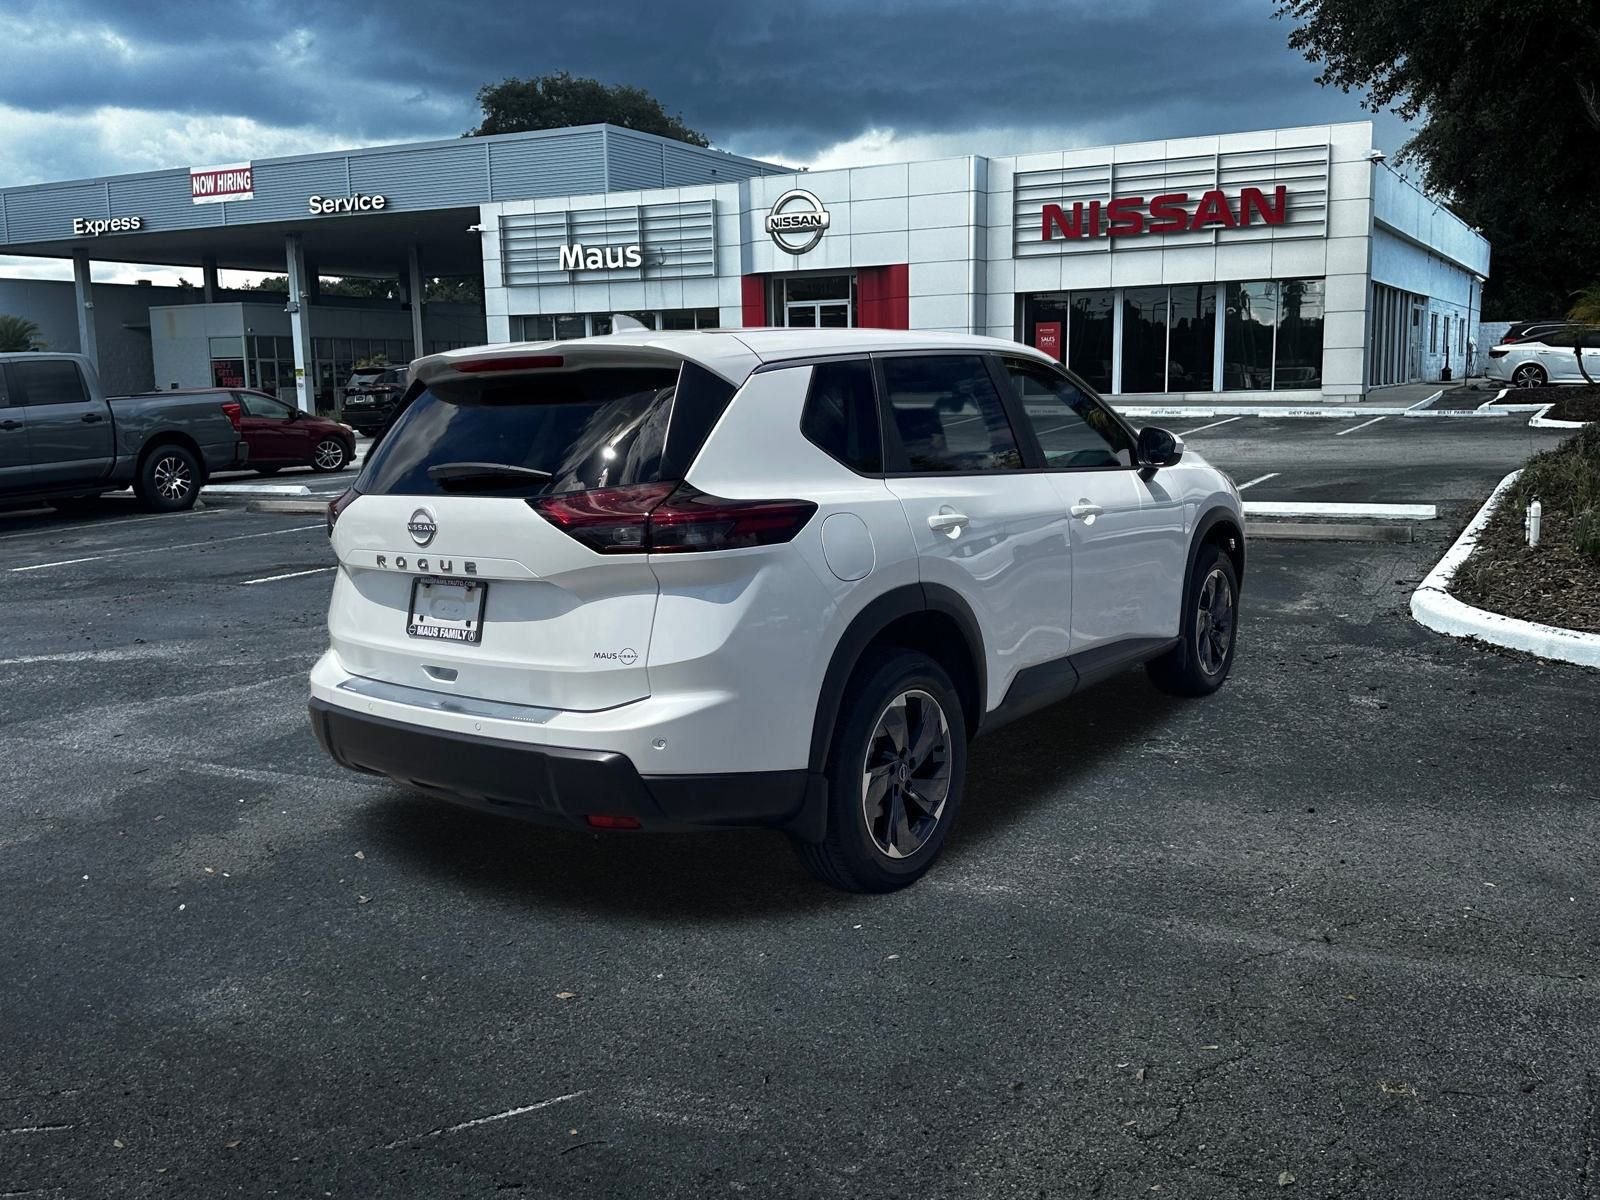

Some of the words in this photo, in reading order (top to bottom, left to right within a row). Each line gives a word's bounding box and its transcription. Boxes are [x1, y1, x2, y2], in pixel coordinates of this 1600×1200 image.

[193, 174, 215, 195] NOW
[217, 171, 251, 193] HIRING
[309, 192, 386, 215] Service
[1041, 185, 1287, 241] NISSAN
[73, 215, 141, 236] Express
[770, 214, 822, 230] NISSAN
[559, 243, 642, 271] Maus
[376, 554, 477, 575] ROGUE
[416, 625, 439, 637] MAUS
[440, 628, 468, 641] FAMILY
[593, 652, 618, 660] MAUS
